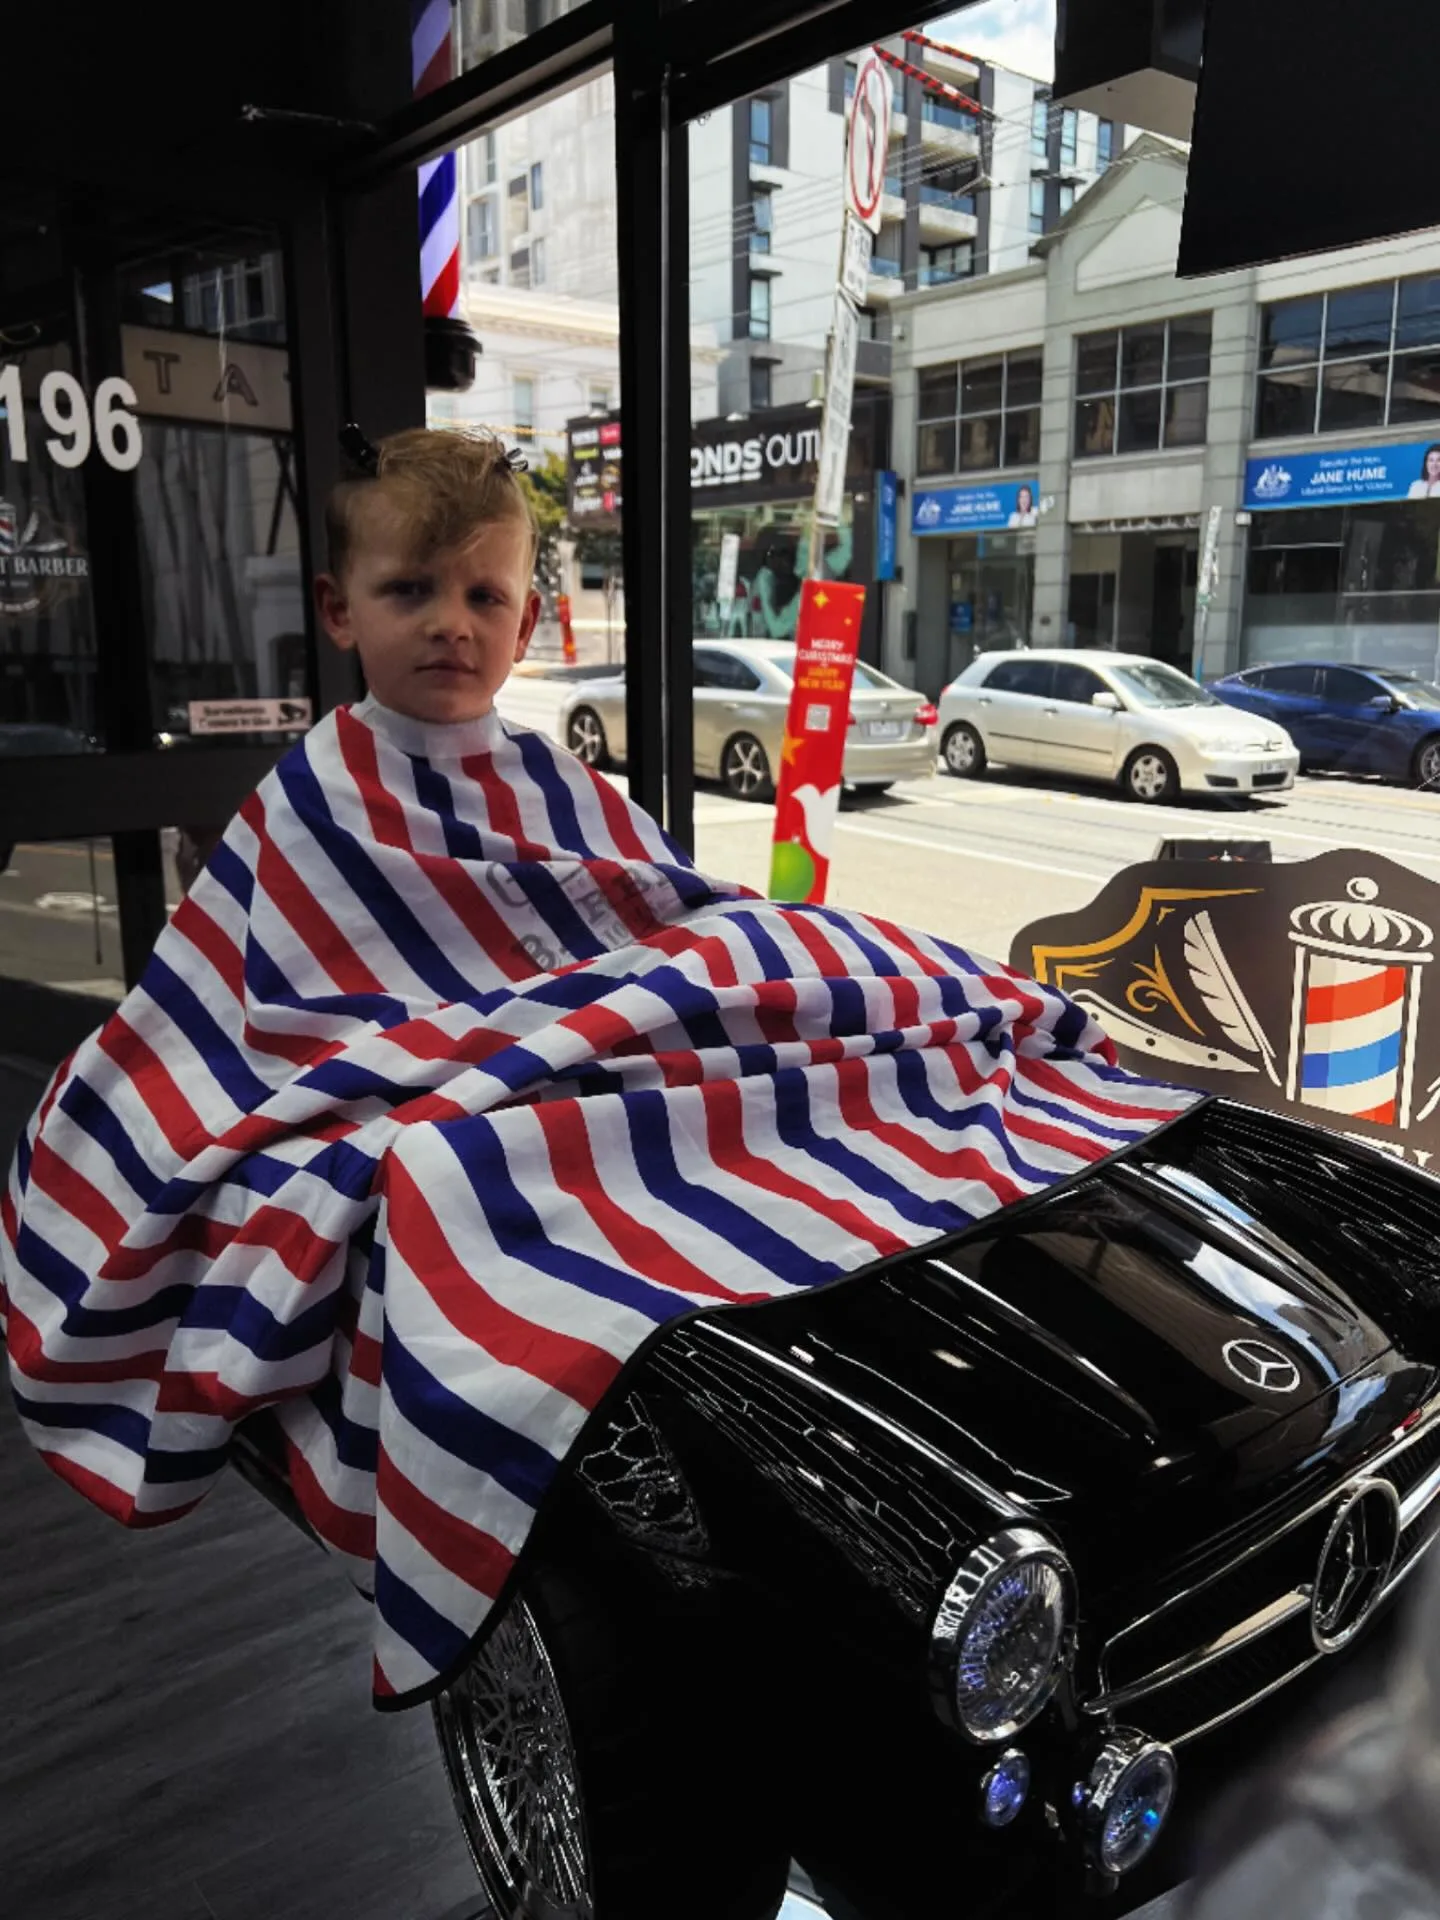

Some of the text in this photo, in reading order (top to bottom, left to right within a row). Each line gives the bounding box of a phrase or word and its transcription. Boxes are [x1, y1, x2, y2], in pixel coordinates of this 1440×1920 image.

[0, 363, 142, 472] 196
[690, 438, 763, 478] ONDS
[1310, 466, 1387, 486] JANE HUME
[14, 556, 88, 577] BARBER
